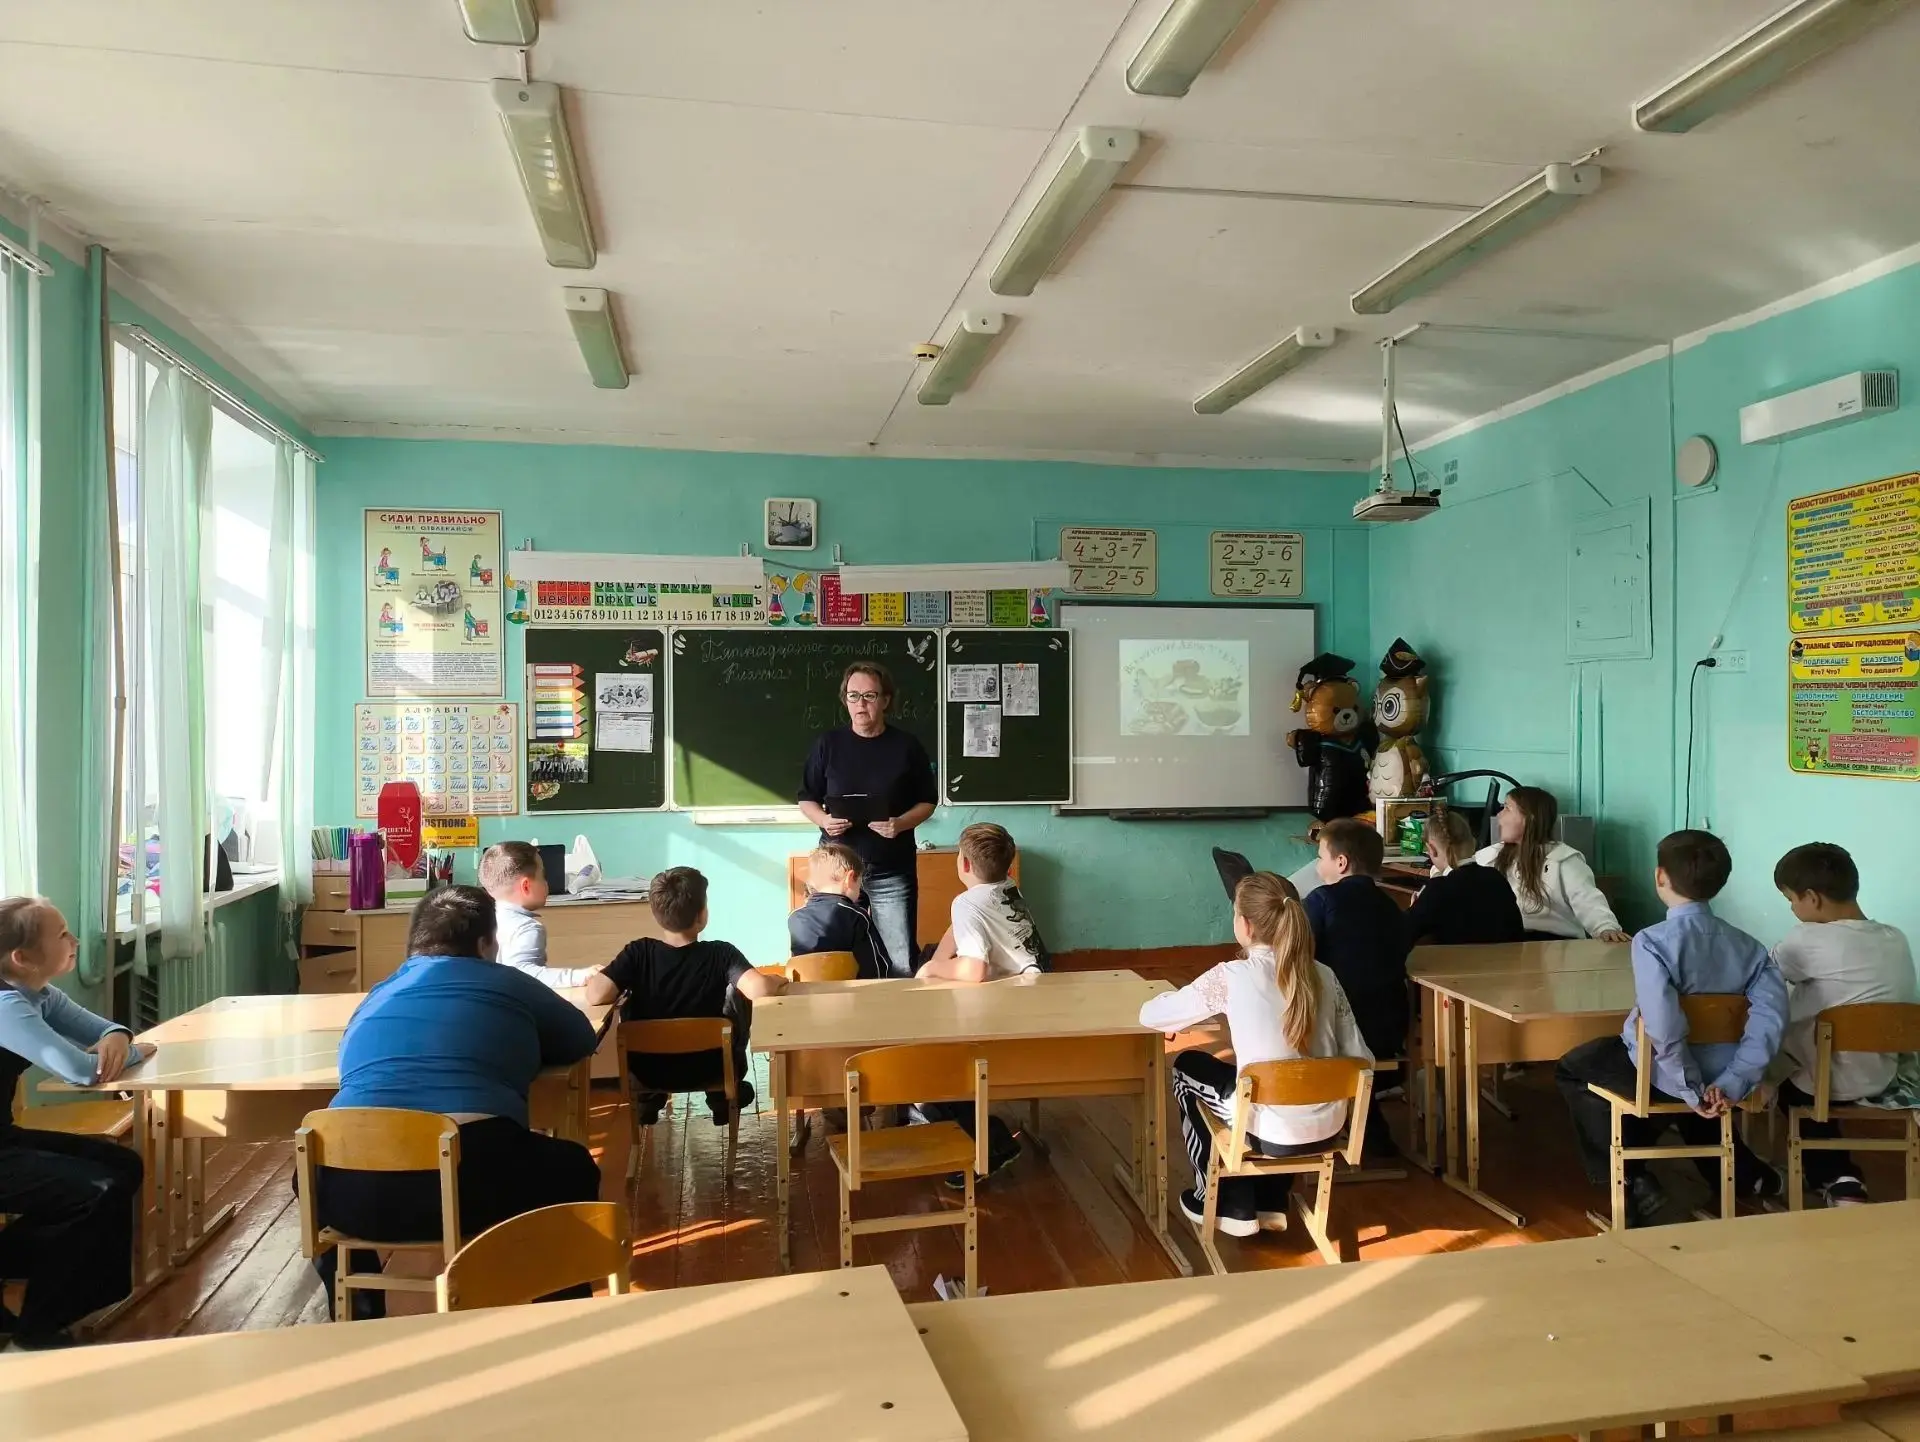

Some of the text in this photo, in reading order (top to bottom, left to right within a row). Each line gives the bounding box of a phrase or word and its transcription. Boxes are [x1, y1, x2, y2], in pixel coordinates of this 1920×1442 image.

[1791, 476, 1920, 511] САМОСТОЯТЕЛЬНЫЕ ЧАСТИ РЕЧИ
[380, 514, 488, 525] СИДИ ПРАВИЛЬНО
[1073, 541, 1086, 558] 4
[1091, 544, 1100, 553] +
[1105, 542, 1118, 559] 3
[1132, 543, 1144, 560] 7
[1222, 544, 1235, 560] 2
[1252, 545, 1265, 561] 3
[1281, 545, 1294, 562] 6
[1073, 569, 1084, 585] 7
[1105, 570, 1119, 586] 2
[1133, 570, 1145, 587] 5
[1223, 571, 1235, 588] 8
[1253, 572, 1267, 588] 2
[1279, 573, 1292, 589] 4
[608, 609, 619, 621] 10
[622, 609, 633, 621] 11
[638, 609, 649, 621] 12
[653, 609, 664, 621] 13
[667, 609, 679, 621] 14
[682, 609, 693, 621] 15
[697, 609, 708, 621] 16
[711, 609, 722, 621] 17
[726, 609, 737, 621] 18
[740, 609, 751, 621] 19
[754, 609, 765, 621] 20
[1804, 639, 1906, 650] ГЛАВНЫЕ ЧЛЕНЫ ПРЕДЛОЖЕНИЯ
[1861, 656, 1904, 664] СКАЗУЕМОЕ
[1827, 667, 1841, 675] Что?
